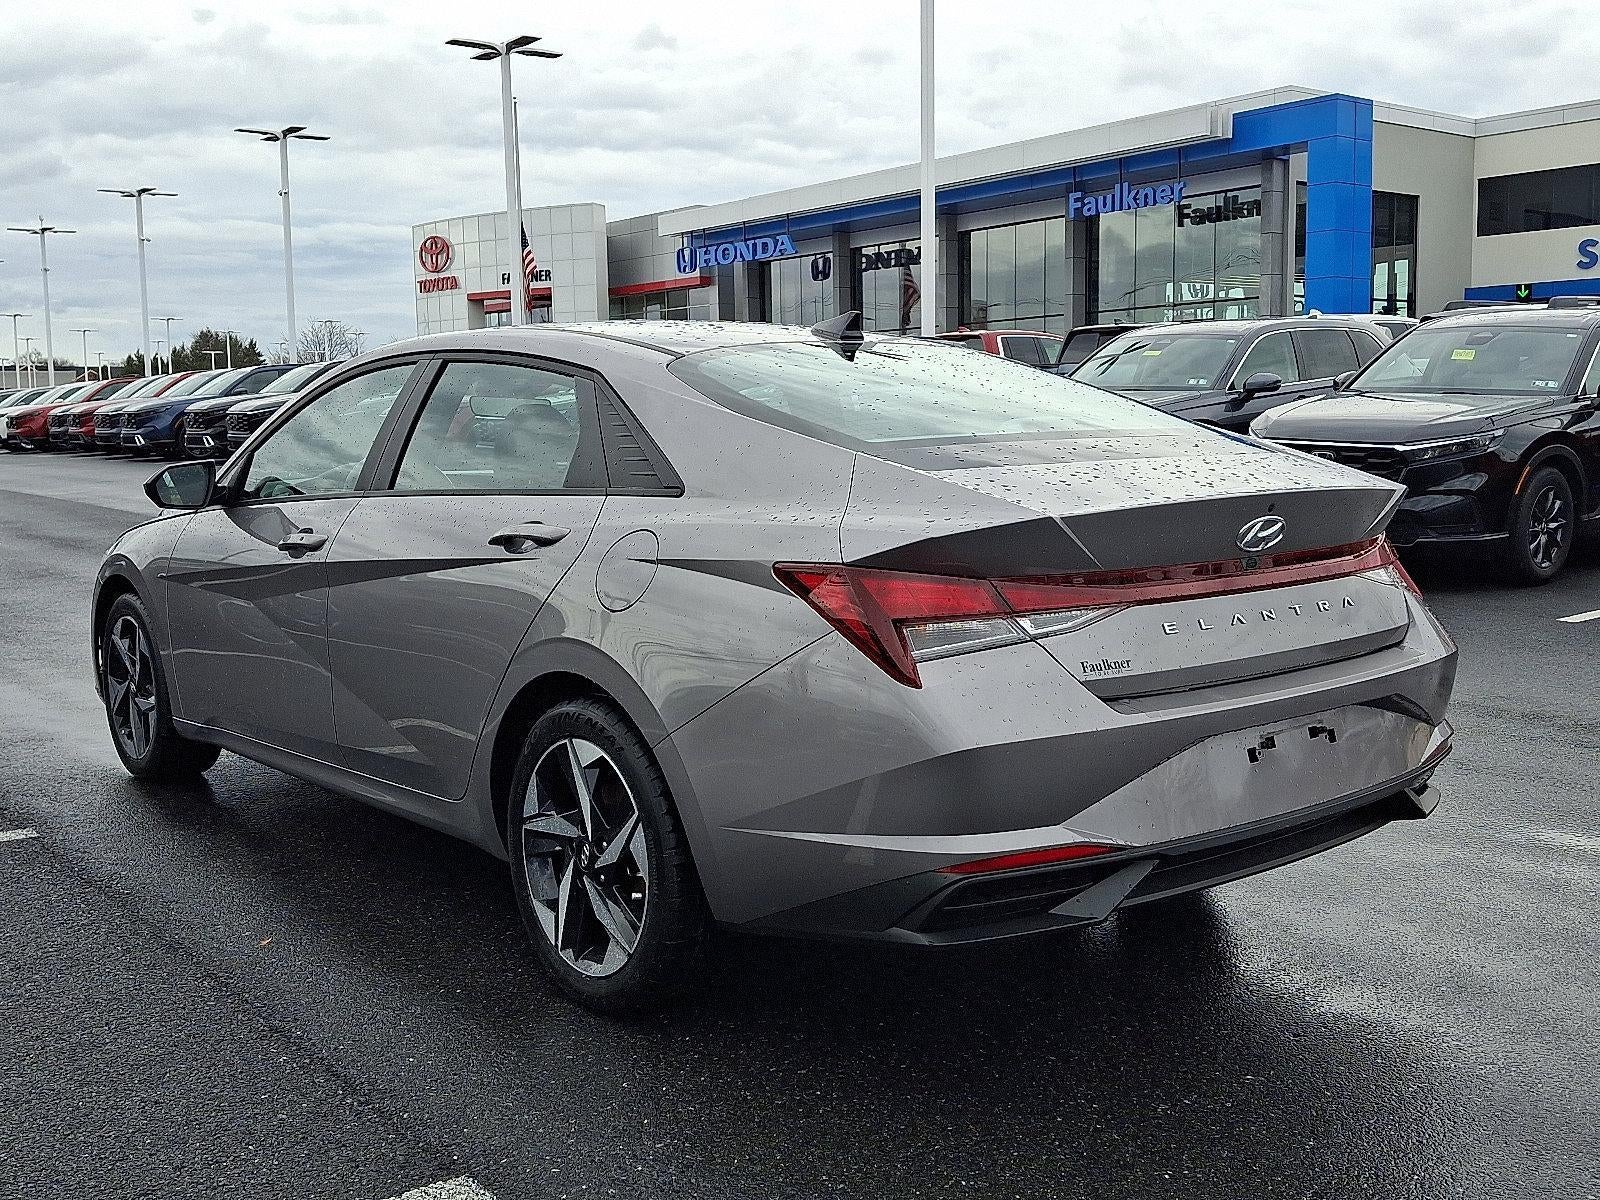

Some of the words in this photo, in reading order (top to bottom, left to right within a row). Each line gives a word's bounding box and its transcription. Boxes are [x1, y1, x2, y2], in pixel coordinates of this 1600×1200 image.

[1068, 181, 1186, 220] Faulkner
[698, 234, 798, 268] HONDA
[417, 275, 459, 294] TOYOTA
[1162, 596, 1355, 635] ELANTRA
[1080, 659, 1131, 673] Faulkner
